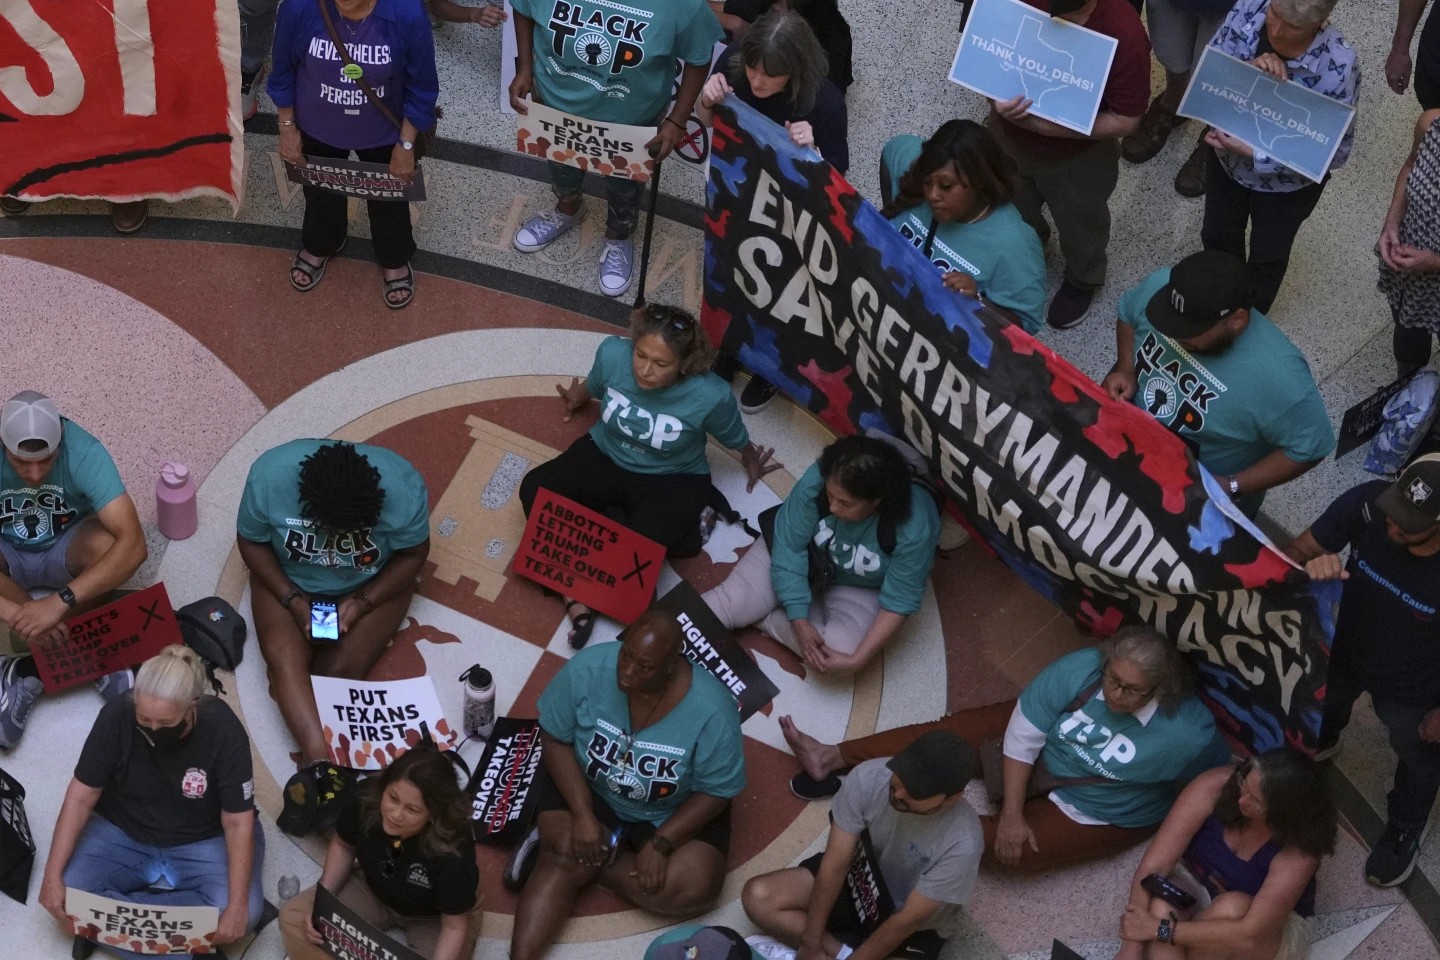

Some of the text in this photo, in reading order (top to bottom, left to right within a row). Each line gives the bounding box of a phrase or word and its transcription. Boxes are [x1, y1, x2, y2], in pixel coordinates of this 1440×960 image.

[552, 0, 650, 44] BLACK
[972, 34, 1095, 92] THANK YOU, DEMS!
[562, 117, 609, 138] PUT
[1201, 82, 1249, 106] THANK
[1253, 102, 1284, 124] YOU,
[1287, 119, 1329, 145] DEMS!
[539, 119, 634, 153] TEXANS
[554, 135, 620, 161] FIRST
[311, 180, 404, 198] TAKEOVER
[749, 168, 840, 287] END
[1140, 331, 1219, 413] BLACK
[601, 387, 683, 450] TOP
[735, 236, 1303, 716] SAVE DEMOCRACY
[284, 527, 378, 556] BLACK
[537, 513, 604, 552] LETTING
[542, 500, 620, 544] ABBOTT'S
[535, 526, 590, 558] TRUMP
[524, 555, 575, 589] TEXAS
[530, 538, 617, 588] TAKE OVER
[1358, 560, 1436, 614] Common Cause
[676, 612, 720, 662] FIGHT
[715, 659, 747, 696] THE
[333, 704, 420, 724] TEXANS
[349, 688, 388, 706] PUT
[349, 723, 407, 742] FIRST
[1060, 708, 1137, 764] TOP
[587, 730, 681, 780] BLACK
[186, 775, 204, 784] CWA
[484, 726, 540, 833] TRUMP
[508, 787, 529, 821] THE
[89, 908, 193, 931] TEXANS
[105, 922, 178, 940] FIRST
[116, 905, 167, 920] PUT
[332, 912, 379, 952] FIGHT
